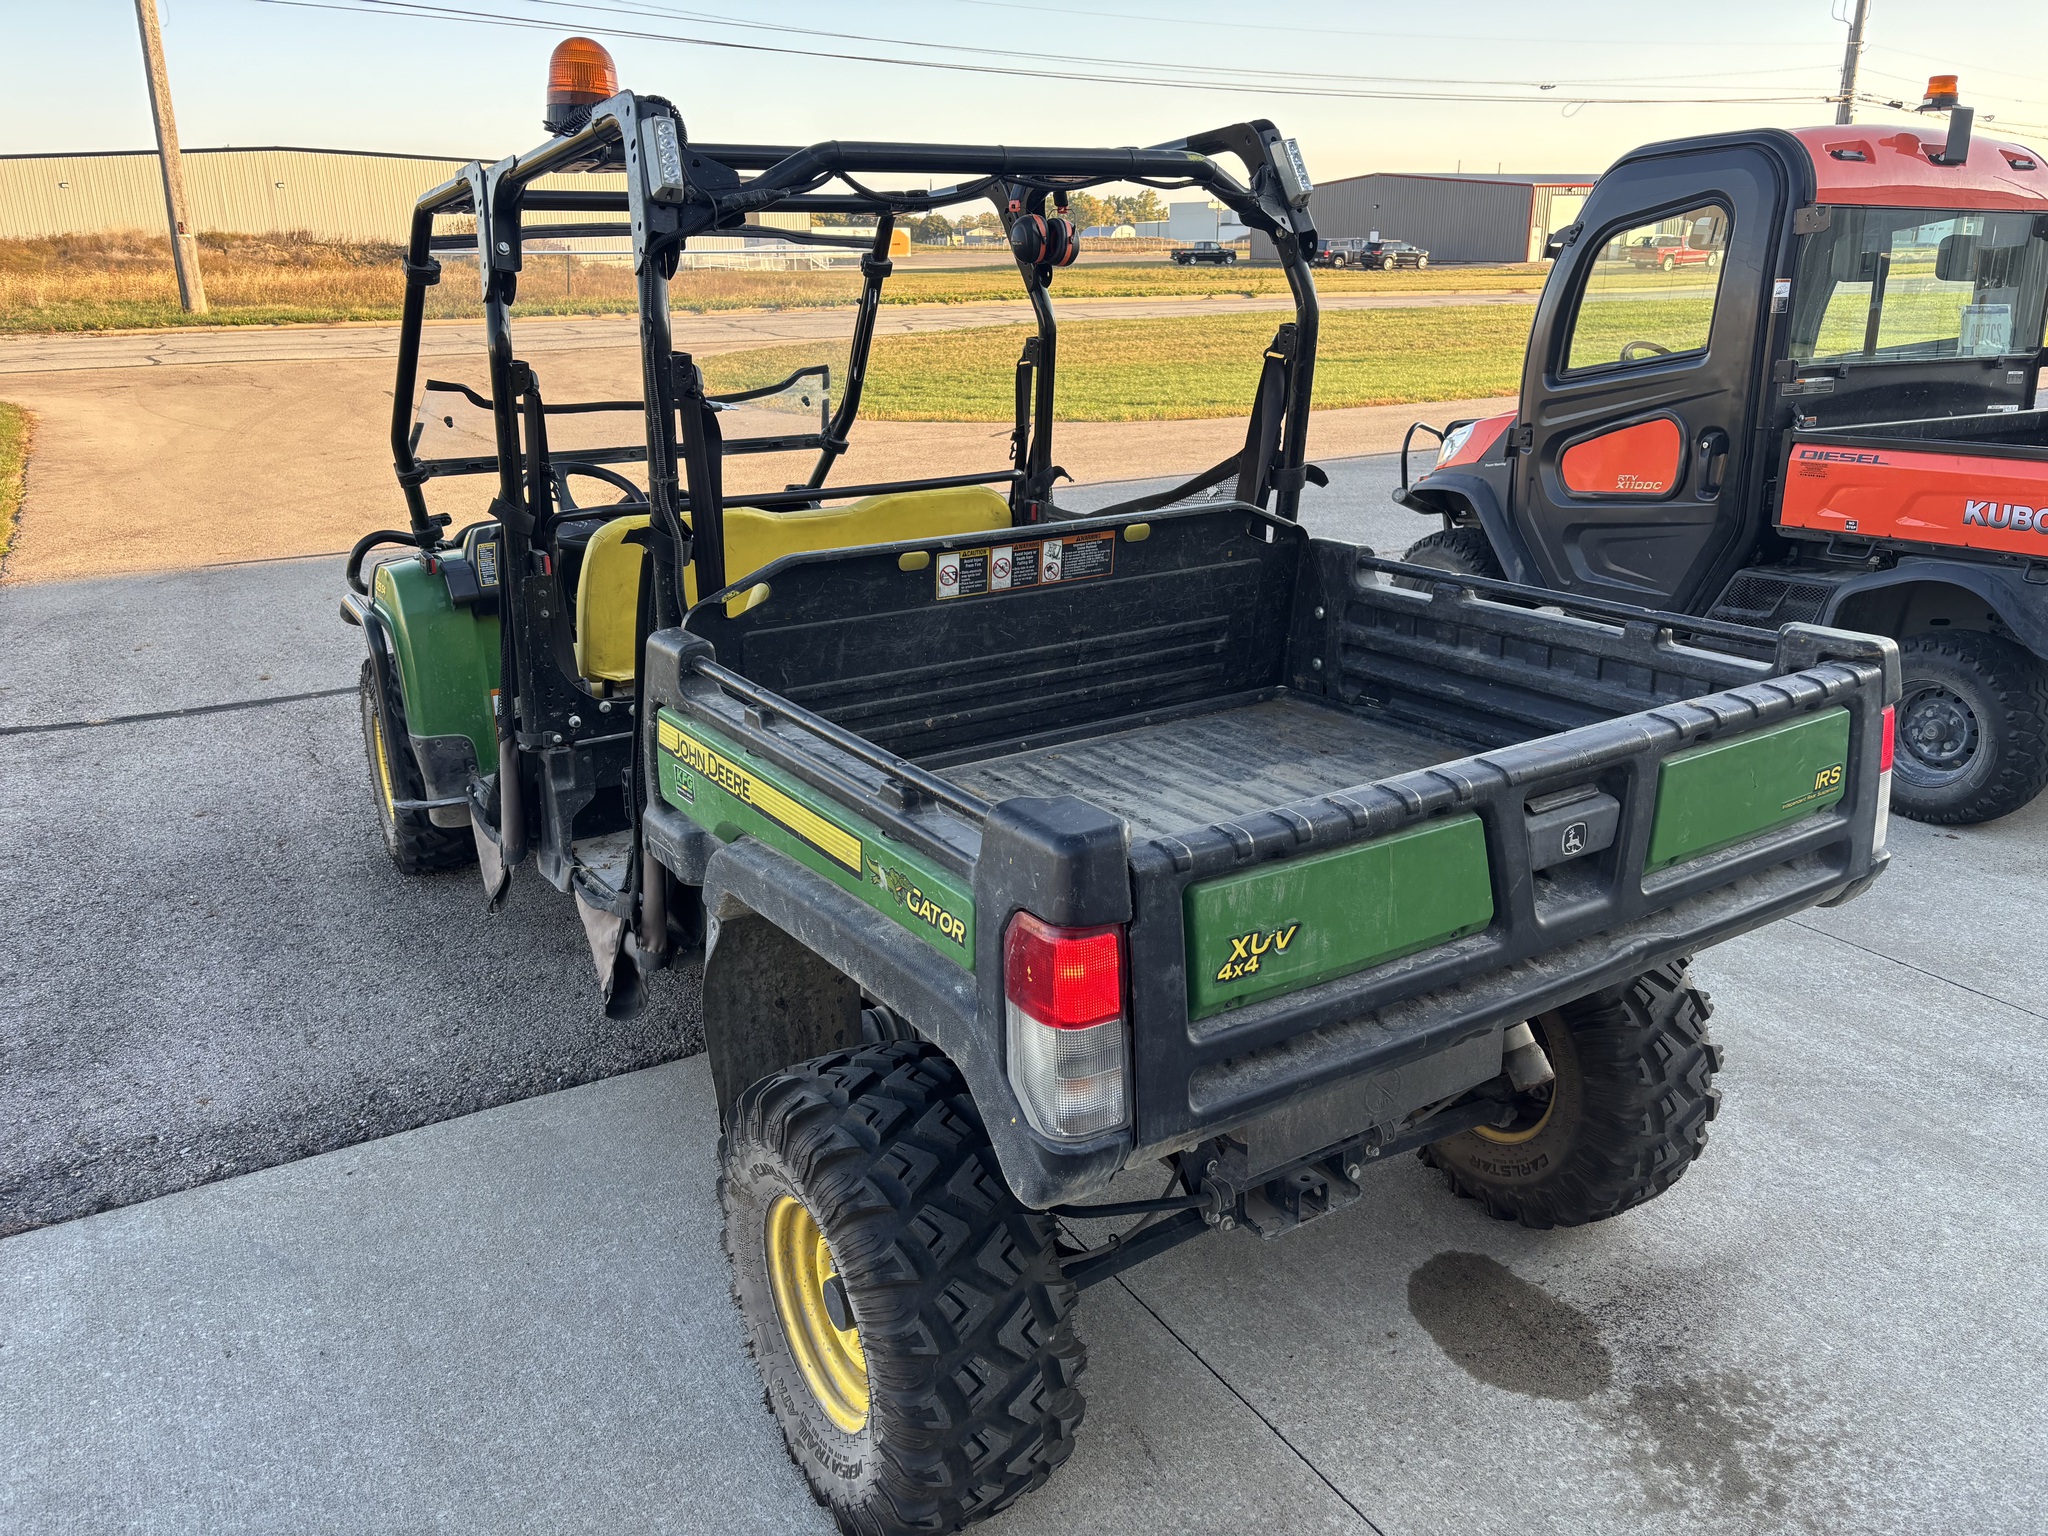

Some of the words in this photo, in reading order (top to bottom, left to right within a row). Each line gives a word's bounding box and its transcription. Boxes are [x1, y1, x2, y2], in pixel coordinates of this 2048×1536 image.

[1800, 450, 1889, 465] DIESEL
[1615, 481, 1663, 490] X1100C
[1019, 541, 1040, 549] WARNING
[673, 733, 706, 774] JOHN
[709, 752, 751, 801] DEERE
[676, 768, 693, 790] KFG
[1814, 765, 1841, 791] IRS
[906, 888, 965, 944] GATOR
[1228, 925, 1297, 962] XUV
[1217, 955, 1260, 980] 4x4
[1469, 1153, 1549, 1177] CARLSTAR
[775, 1377, 799, 1416] ATR
